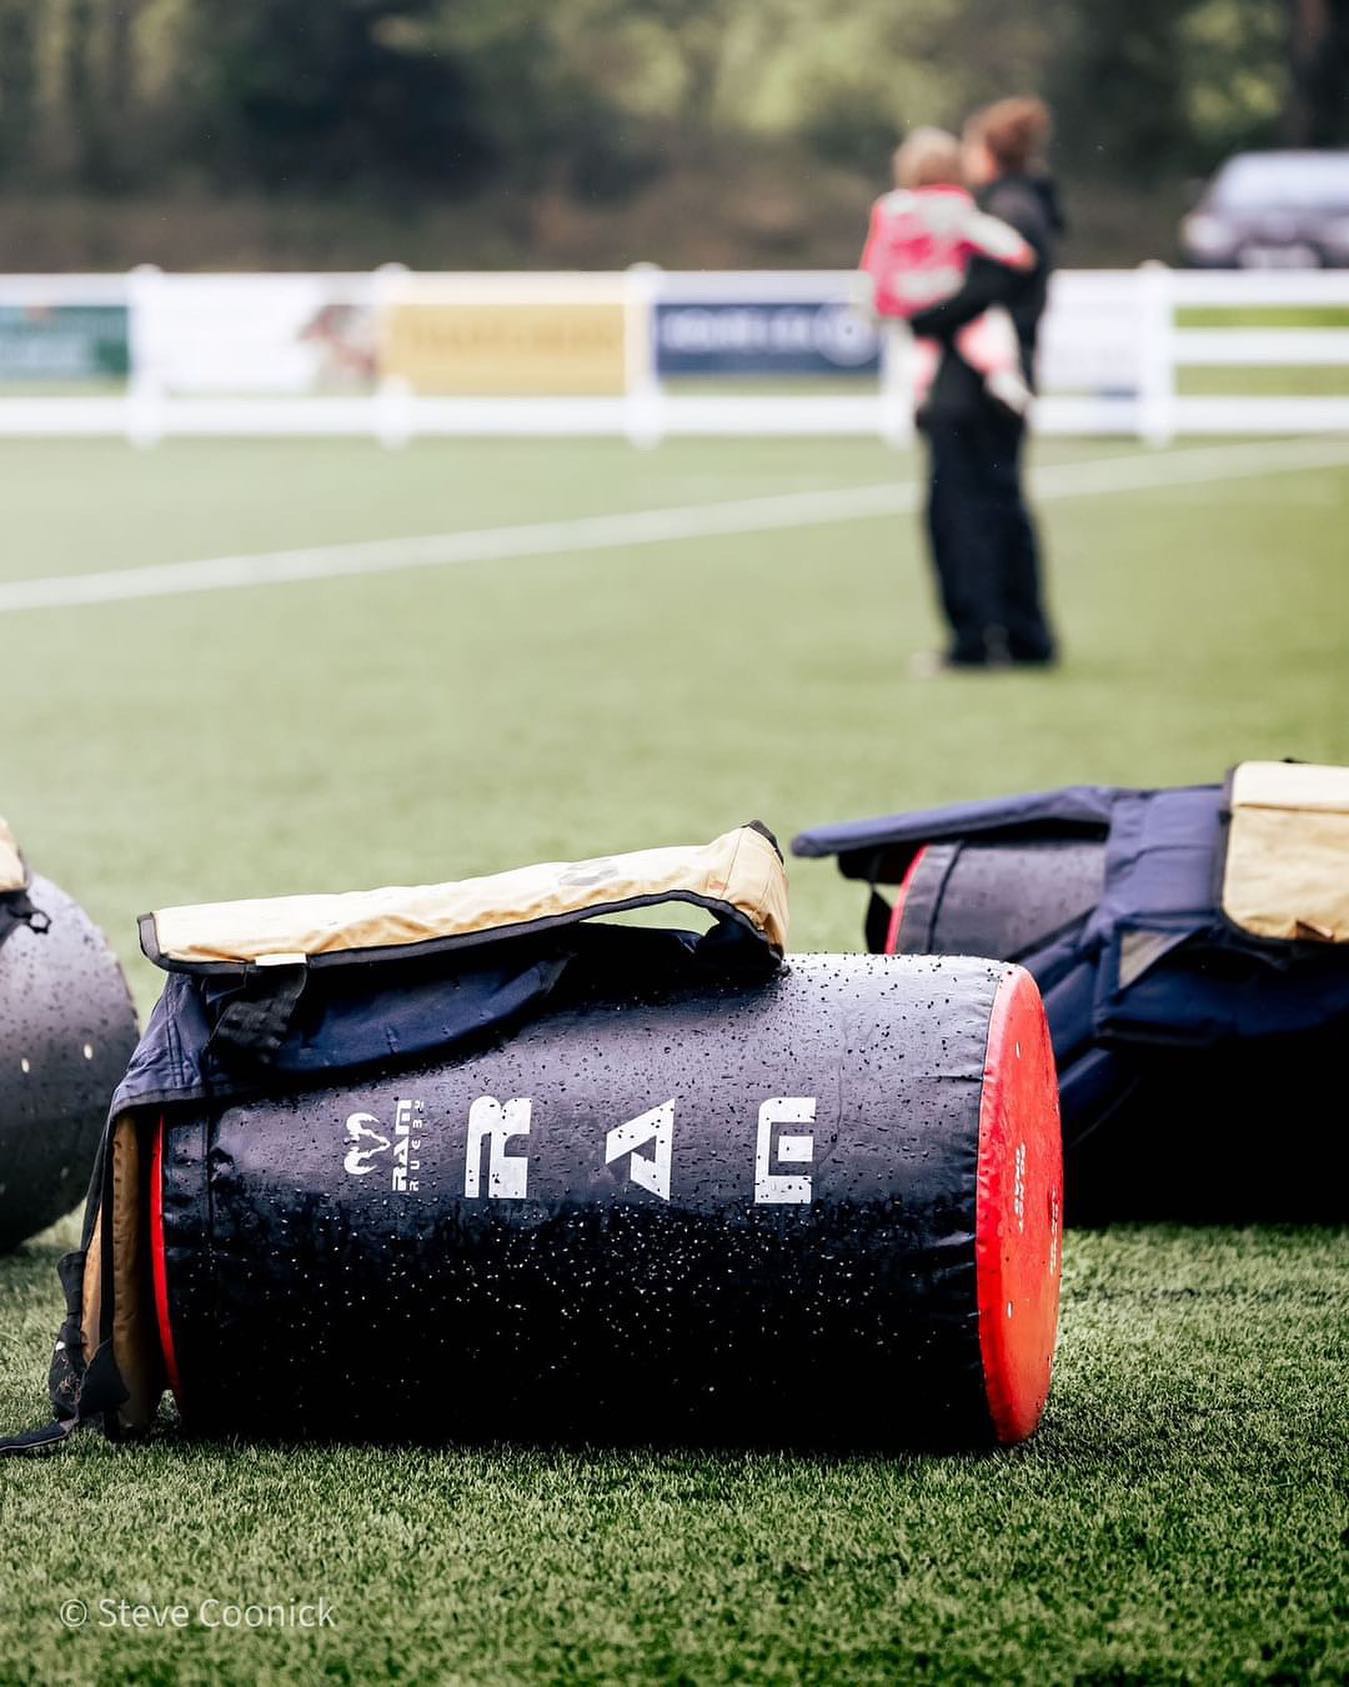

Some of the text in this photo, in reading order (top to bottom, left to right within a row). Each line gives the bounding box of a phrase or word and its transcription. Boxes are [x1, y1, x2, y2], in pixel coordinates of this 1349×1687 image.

[392, 1100, 411, 1191] RAM
[409, 1101, 424, 1191] RUGBY
[465, 1095, 816, 1204] RAM
